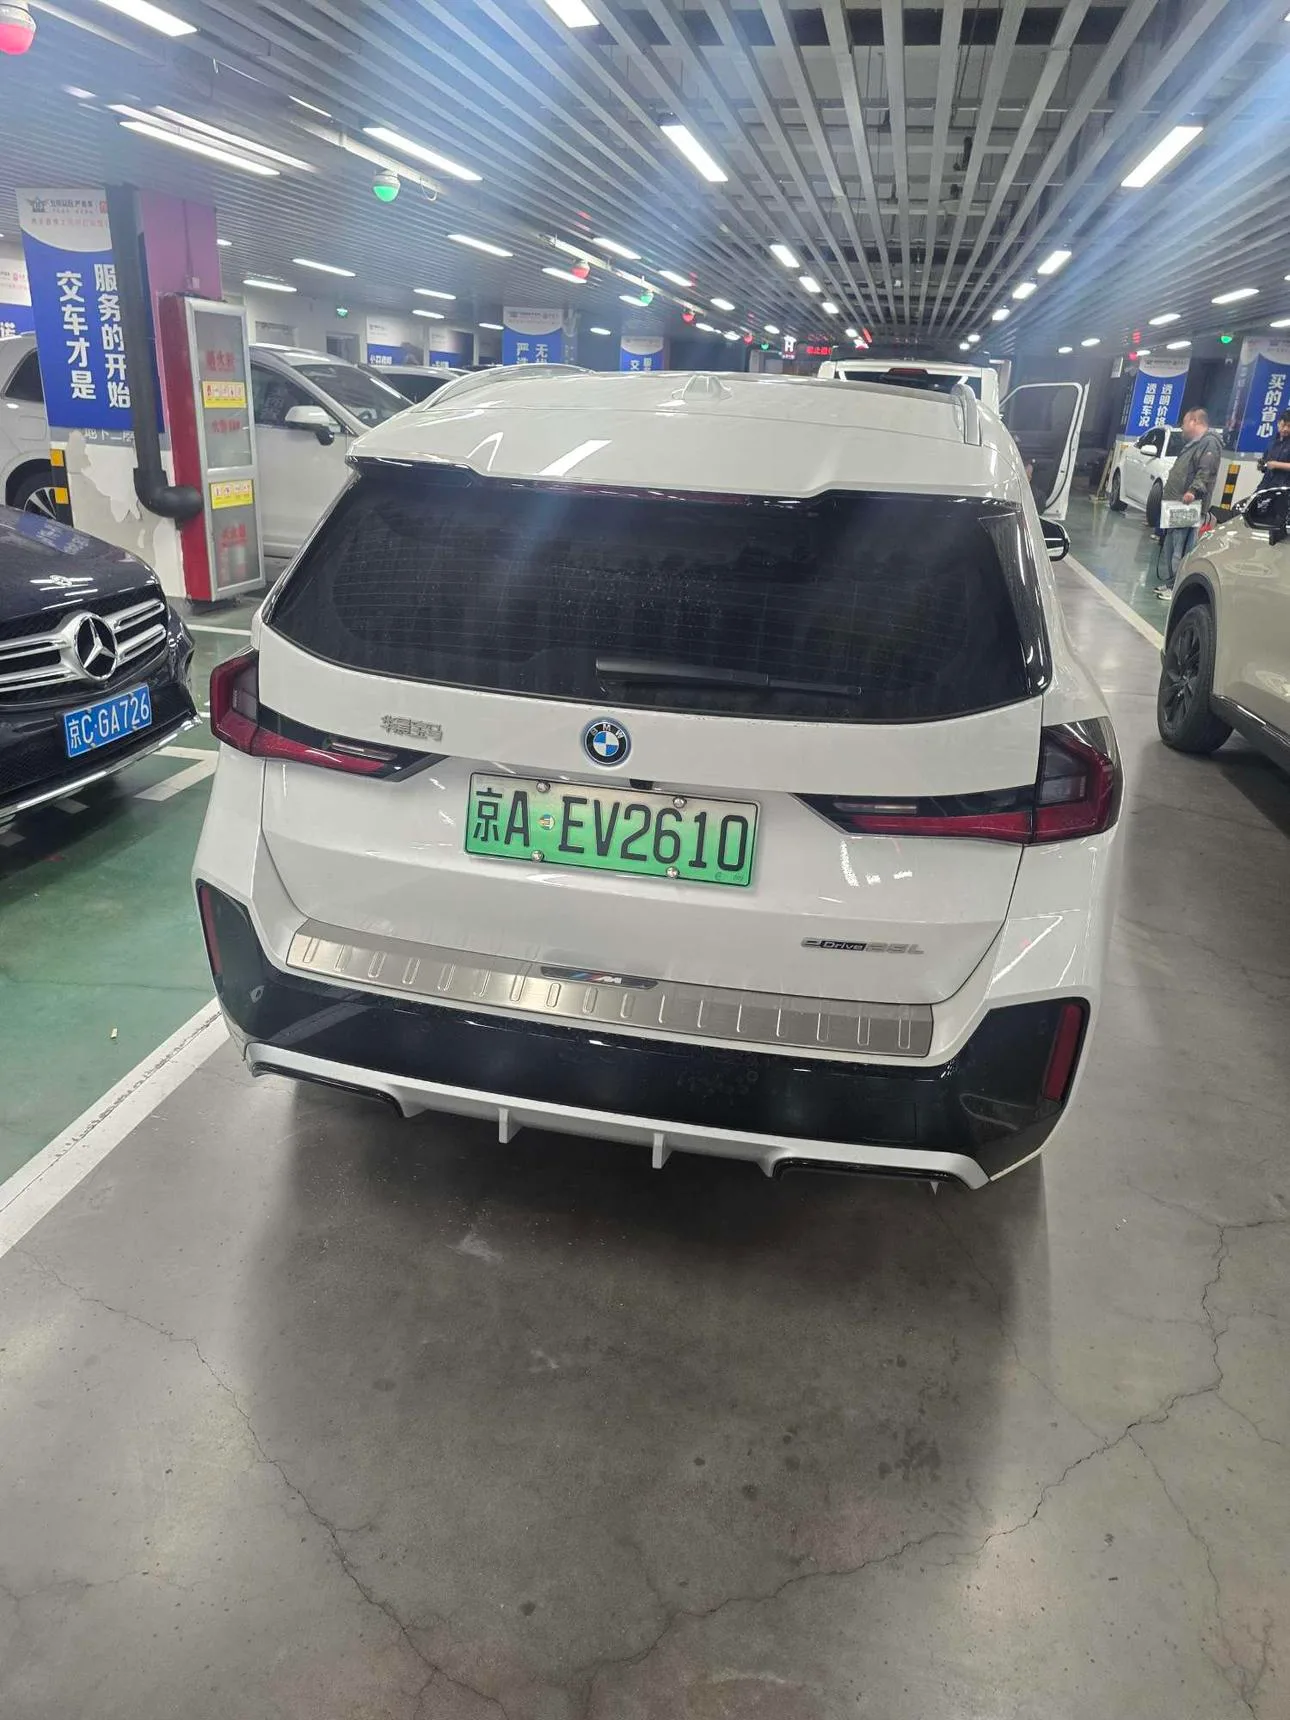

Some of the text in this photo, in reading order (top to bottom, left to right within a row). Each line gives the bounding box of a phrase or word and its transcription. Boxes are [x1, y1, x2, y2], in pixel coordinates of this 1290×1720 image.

[56, 271, 96, 400] 交车才是
[94, 264, 131, 408] 服务的开始
[1138, 383, 1157, 427] 透明车况
[1154, 384, 1173, 428] 透明价格
[1256, 374, 1286, 437] 买的省心
